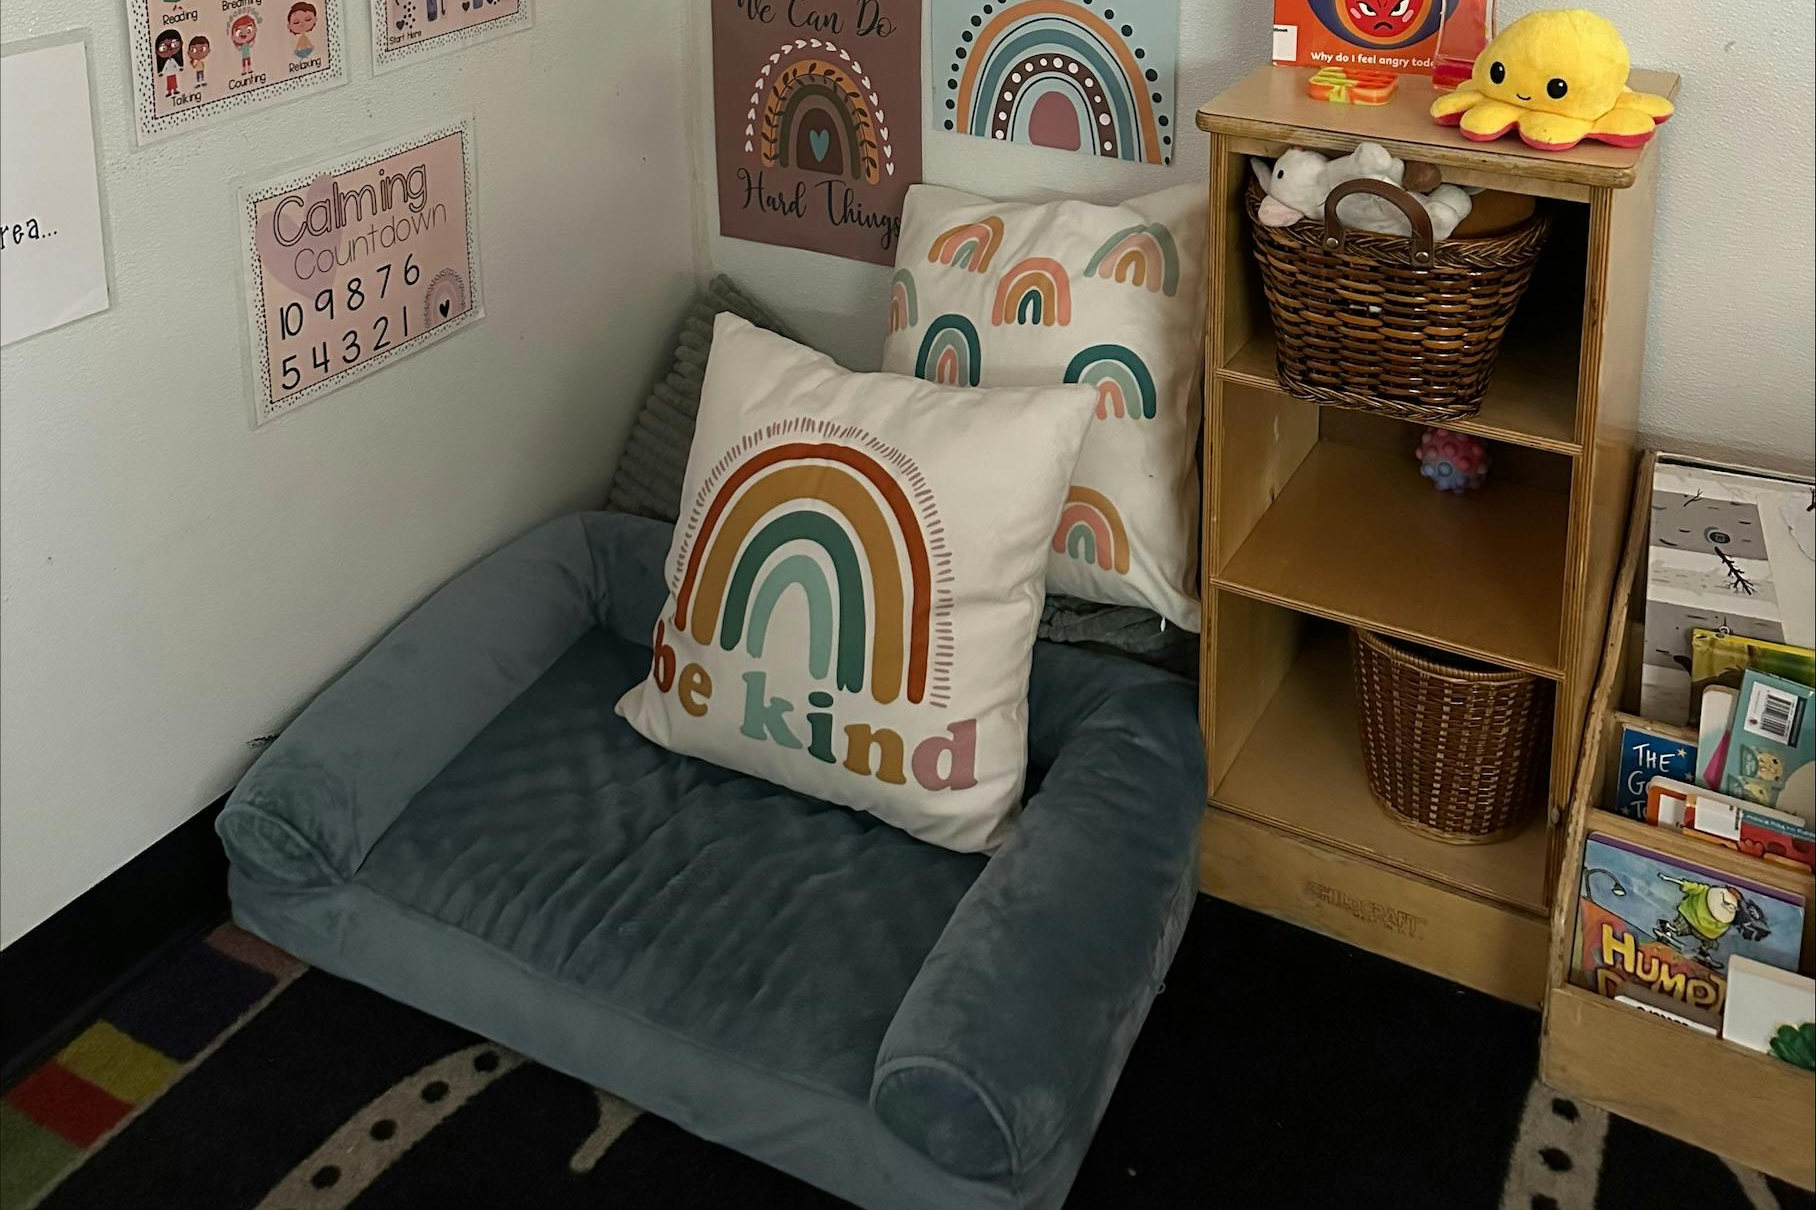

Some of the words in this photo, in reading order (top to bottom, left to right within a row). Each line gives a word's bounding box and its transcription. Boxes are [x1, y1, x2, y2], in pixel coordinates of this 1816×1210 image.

[162, 8, 199, 26] Reading
[389, 32, 405, 45] Start
[288, 56, 322, 75] Relaxing
[1311, 51, 1333, 63] Why
[1335, 52, 1349, 63] do
[1351, 54, 1355, 63] I
[1357, 54, 1377, 64] feel
[1378, 56, 1410, 68] angry
[228, 72, 267, 91] Counting
[170, 91, 202, 108] Talking
[272, 163, 429, 247] Calming
[736, 166, 807, 219] Hard
[814, 179, 901, 251] Things
[293, 202, 447, 281] Countdown
[279, 302, 304, 340] 10
[315, 289, 335, 320] 9
[346, 277, 365, 311] 8
[376, 264, 392, 299] 7
[403, 253, 420, 286] 6
[281, 354, 301, 391] 5
[312, 341, 330, 374] 4
[342, 330, 361, 364] 3
[373, 316, 391, 352] 2
[402, 306, 409, 337] 1
[653, 618, 713, 718] be
[740, 670, 978, 792] kind
[1632, 742, 1676, 773] THE
